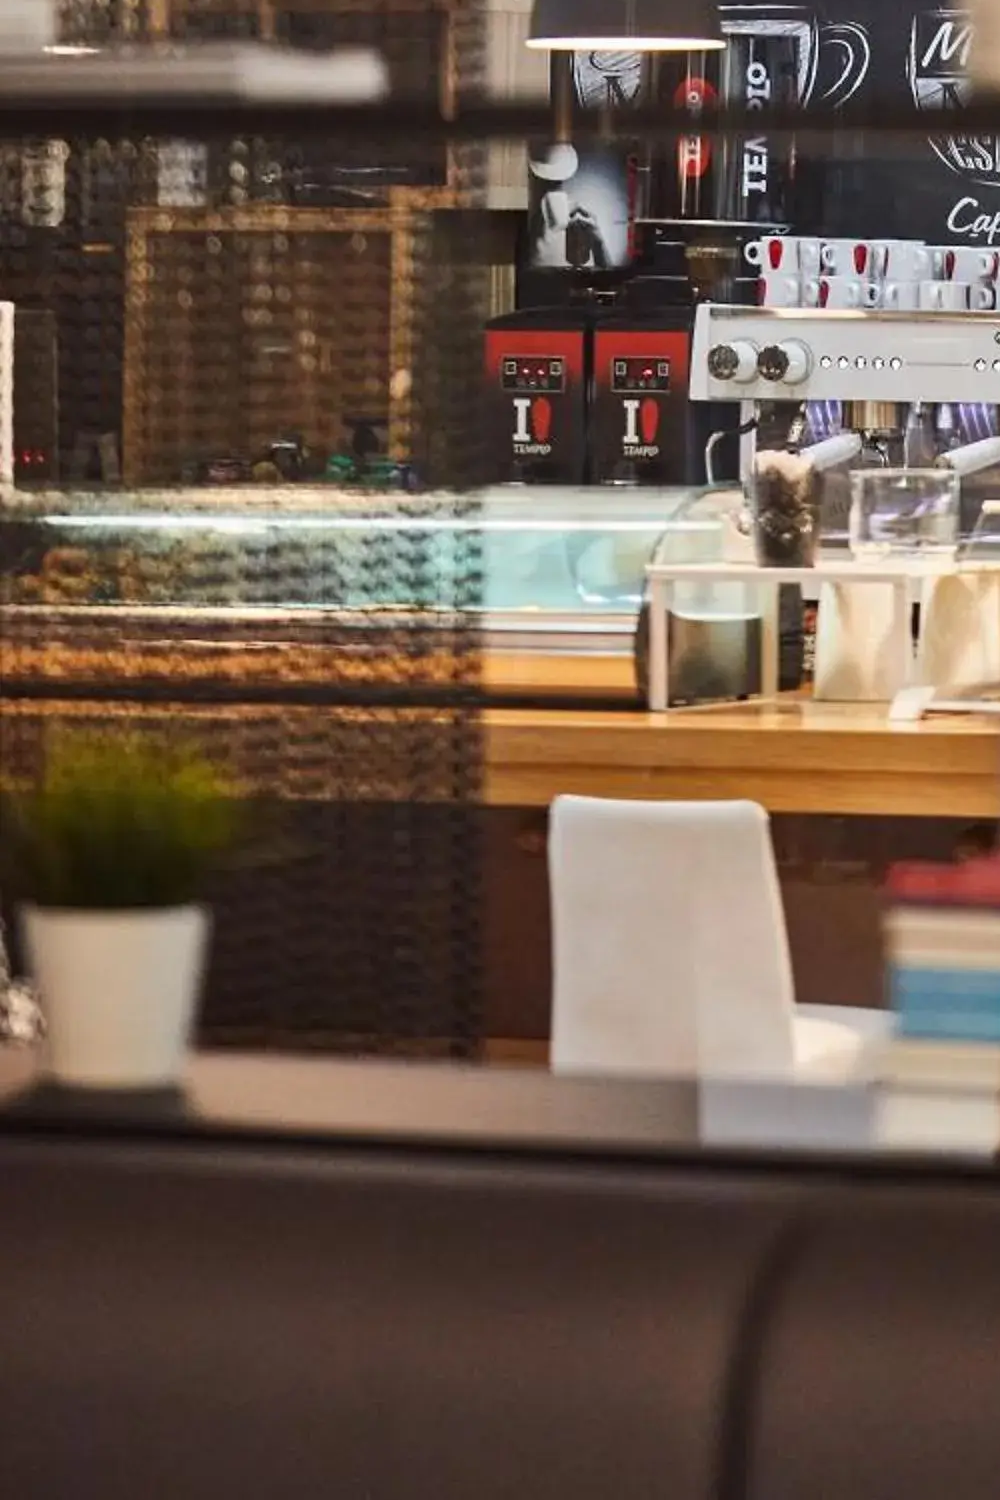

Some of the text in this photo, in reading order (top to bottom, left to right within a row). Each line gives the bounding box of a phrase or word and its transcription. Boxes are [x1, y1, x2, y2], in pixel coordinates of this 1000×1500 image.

[742, 61, 771, 197] TEMIO
[512, 398, 532, 442] I
[622, 400, 640, 443] I
